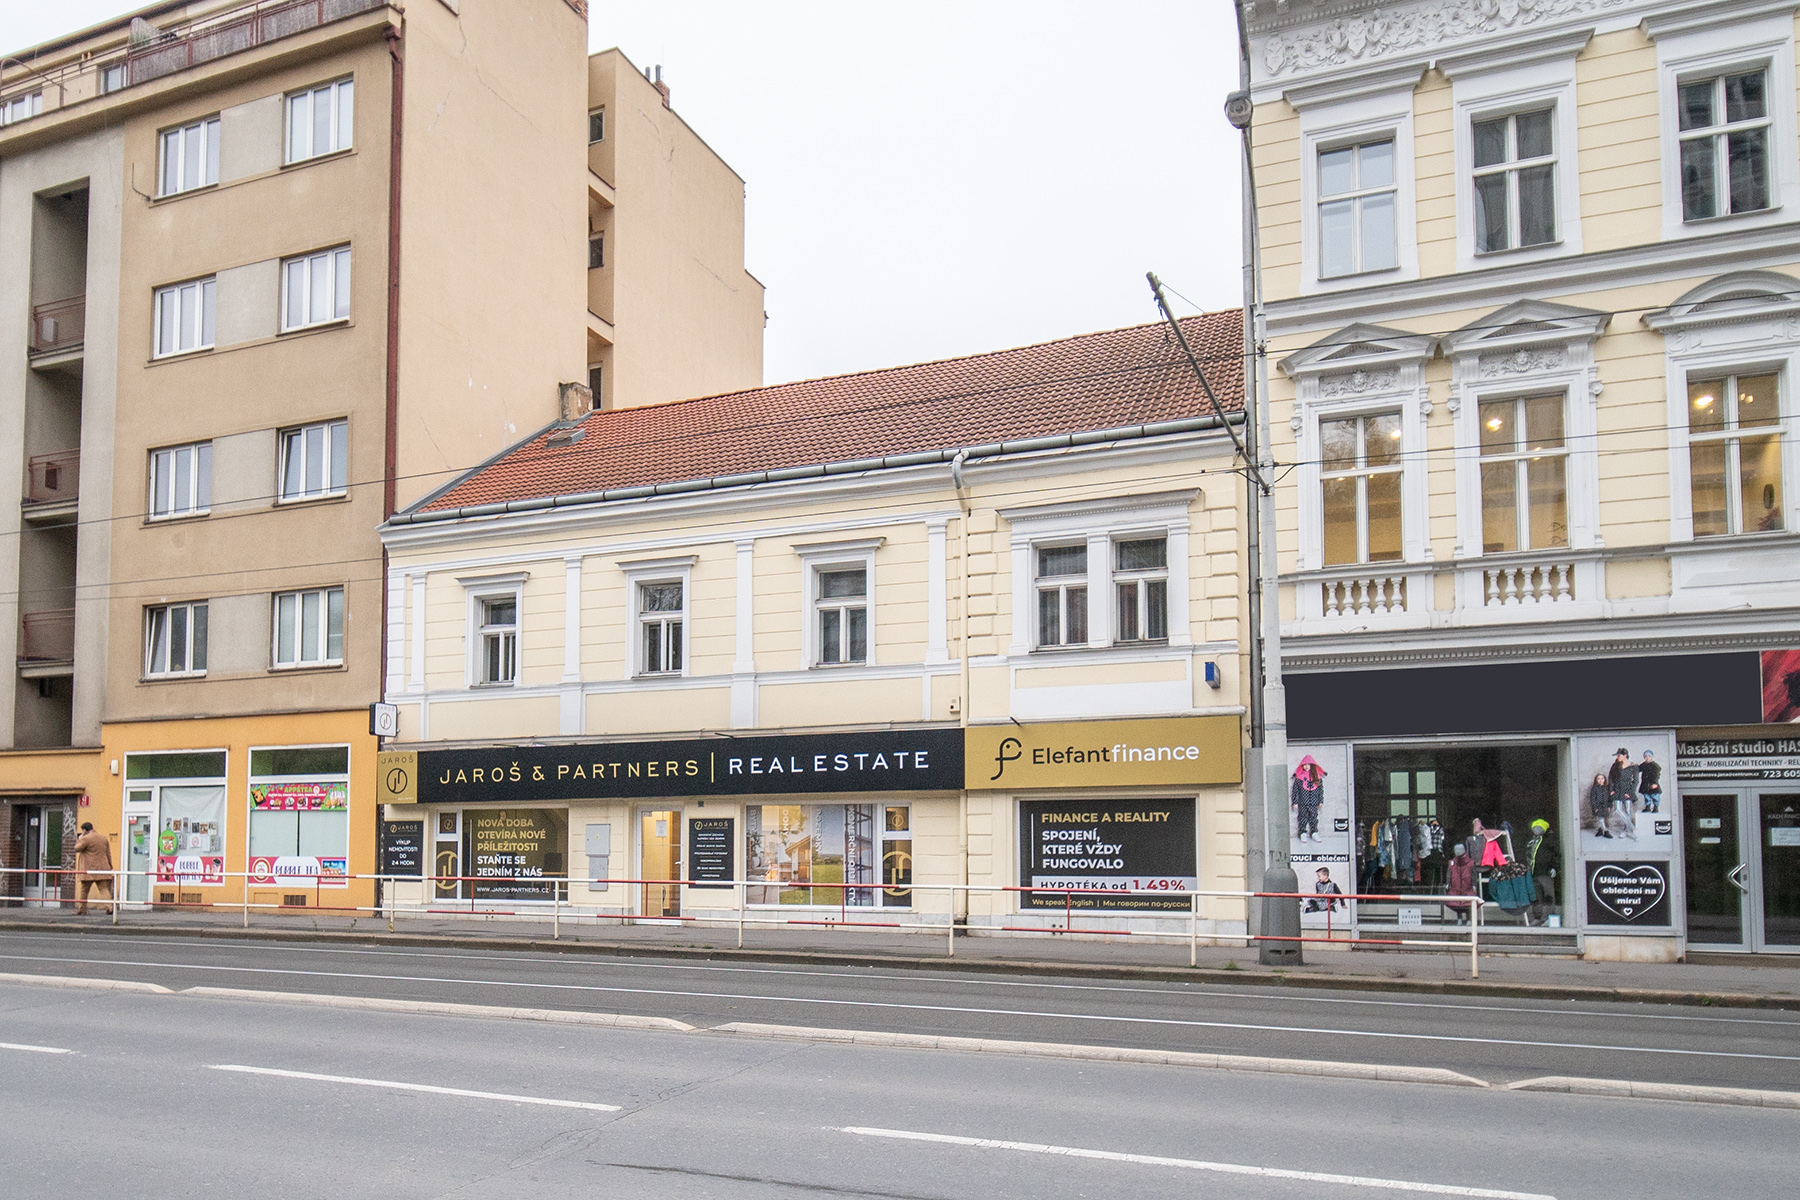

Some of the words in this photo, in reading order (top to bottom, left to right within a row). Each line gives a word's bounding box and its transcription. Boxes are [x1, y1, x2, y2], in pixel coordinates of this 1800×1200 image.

[1676, 741, 1729, 755] Masážní
[1732, 740, 1775, 754] studio
[381, 755, 414, 764] JAROŠ
[1707, 759, 1750, 767] MOBILIZAČNÍ
[1750, 759, 1783, 767] TECHNIKY
[440, 761, 522, 785] JAROŠ
[532, 766, 545, 782] &
[557, 760, 699, 780] PARTNERS
[728, 757, 803, 775] REAL
[813, 751, 929, 772] ESTATE
[1763, 770, 1781, 778] 723
[477, 817, 504, 827] NOVÁ
[506, 819, 534, 827] DOBA
[1041, 812, 1098, 823] FINANCE
[1101, 812, 1112, 823] A
[1115, 811, 1170, 823] REALITY
[477, 829, 518, 839] OTEVÍRÁ
[520, 828, 546, 839] NOVÉ
[815, 808, 823, 853] POZEMKY
[1042, 828, 1101, 842] SPOJENÍ,
[477, 841, 538, 851] PŘÍLEŽITOSTI
[1042, 843, 1084, 855] KTERÉ
[1086, 842, 1122, 855] VŽDY
[477, 853, 513, 864] STAŇTE
[514, 855, 526, 864] SE
[1042, 858, 1124, 869] FUNGOVALO
[477, 866, 513, 876] JEDNÍM
[514, 868, 521, 876] Z
[522, 866, 542, 876] NÁS
[1041, 880, 1107, 890] HYPOTÉKA
[1112, 881, 1127, 890] od
[1133, 879, 1185, 890] 1.49%
[1600, 876, 1637, 885] Ušijeme
[1639, 876, 1661, 884] Vám
[1045, 899, 1066, 907] speak
